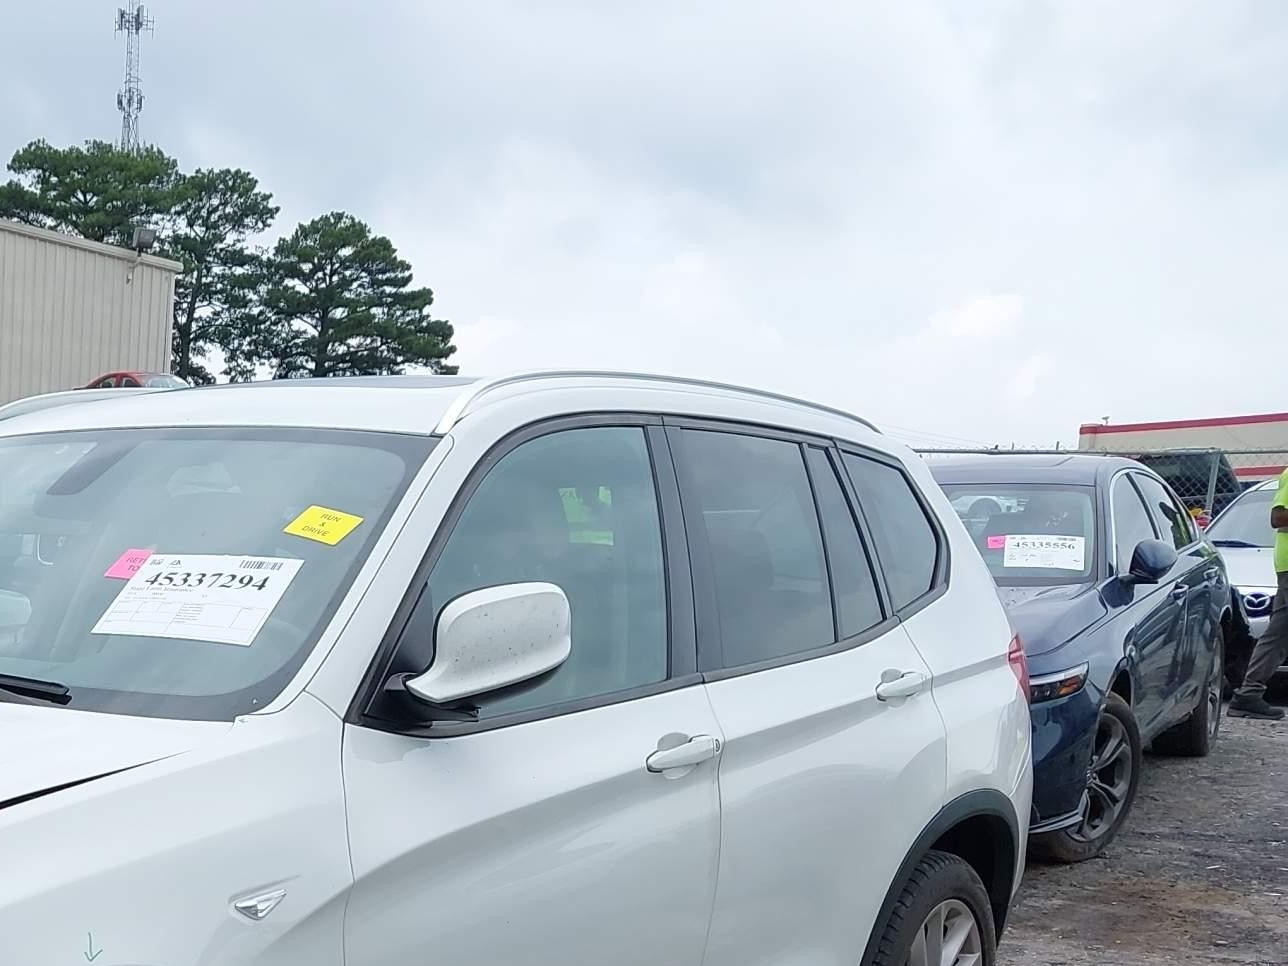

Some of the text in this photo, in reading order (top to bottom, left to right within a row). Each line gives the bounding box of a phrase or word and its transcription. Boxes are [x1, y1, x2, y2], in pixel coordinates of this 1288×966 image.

[320, 513, 342, 522] RUN
[302, 525, 330, 537] DRIVE
[144, 571, 271, 591] 45337294
